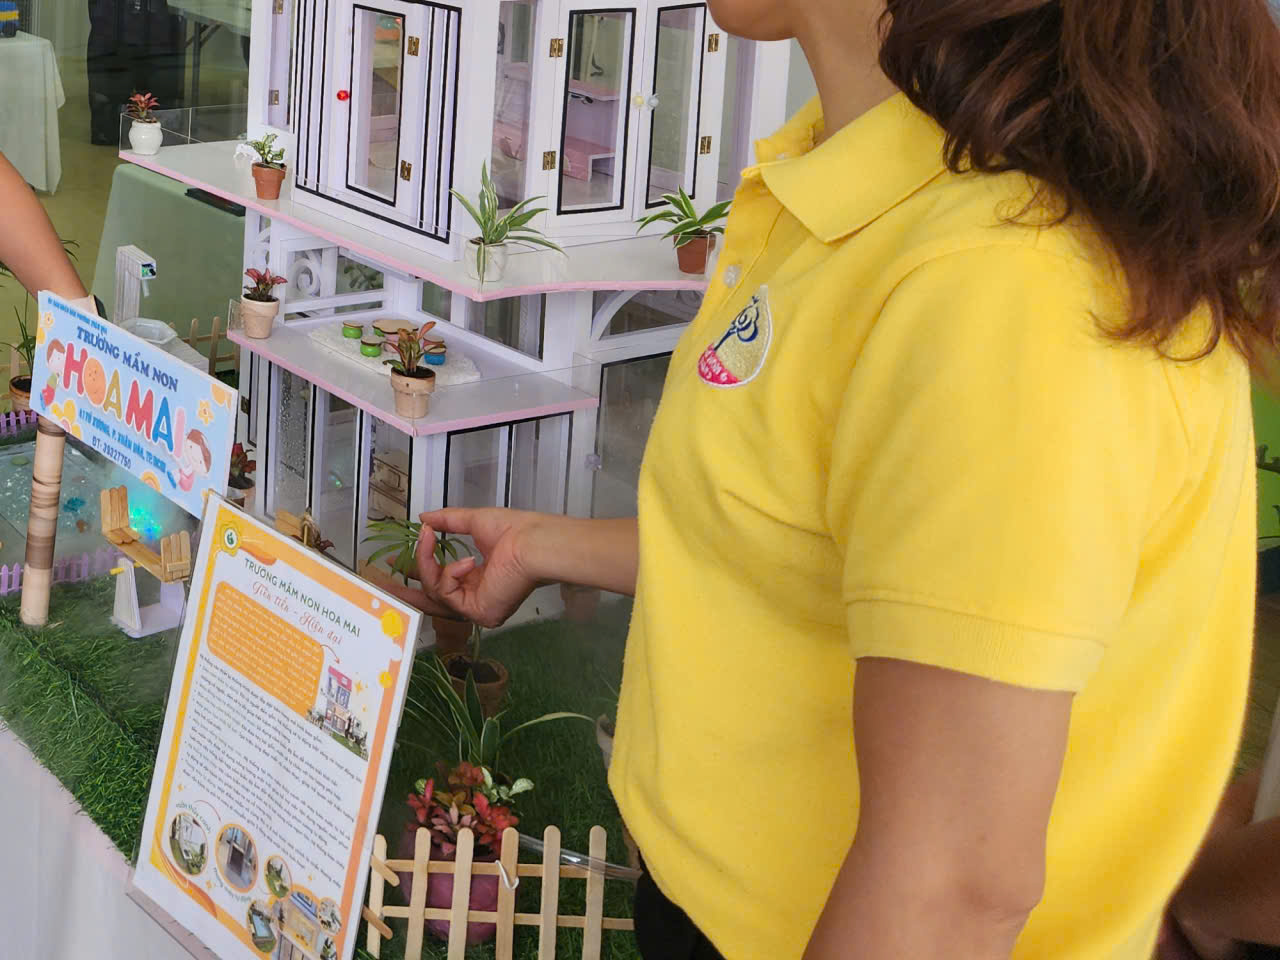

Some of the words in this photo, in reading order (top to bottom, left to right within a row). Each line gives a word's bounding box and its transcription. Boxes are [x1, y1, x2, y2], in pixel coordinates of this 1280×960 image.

[77, 326, 120, 360] TRƯỜNG
[122, 352, 151, 377] MẦM
[152, 367, 178, 393] NON
[63, 342, 123, 420] HOA
[125, 379, 186, 459] MAI
[300, 593, 320, 612] NON
[321, 605, 341, 626] HOA
[343, 620, 361, 638] MAI
